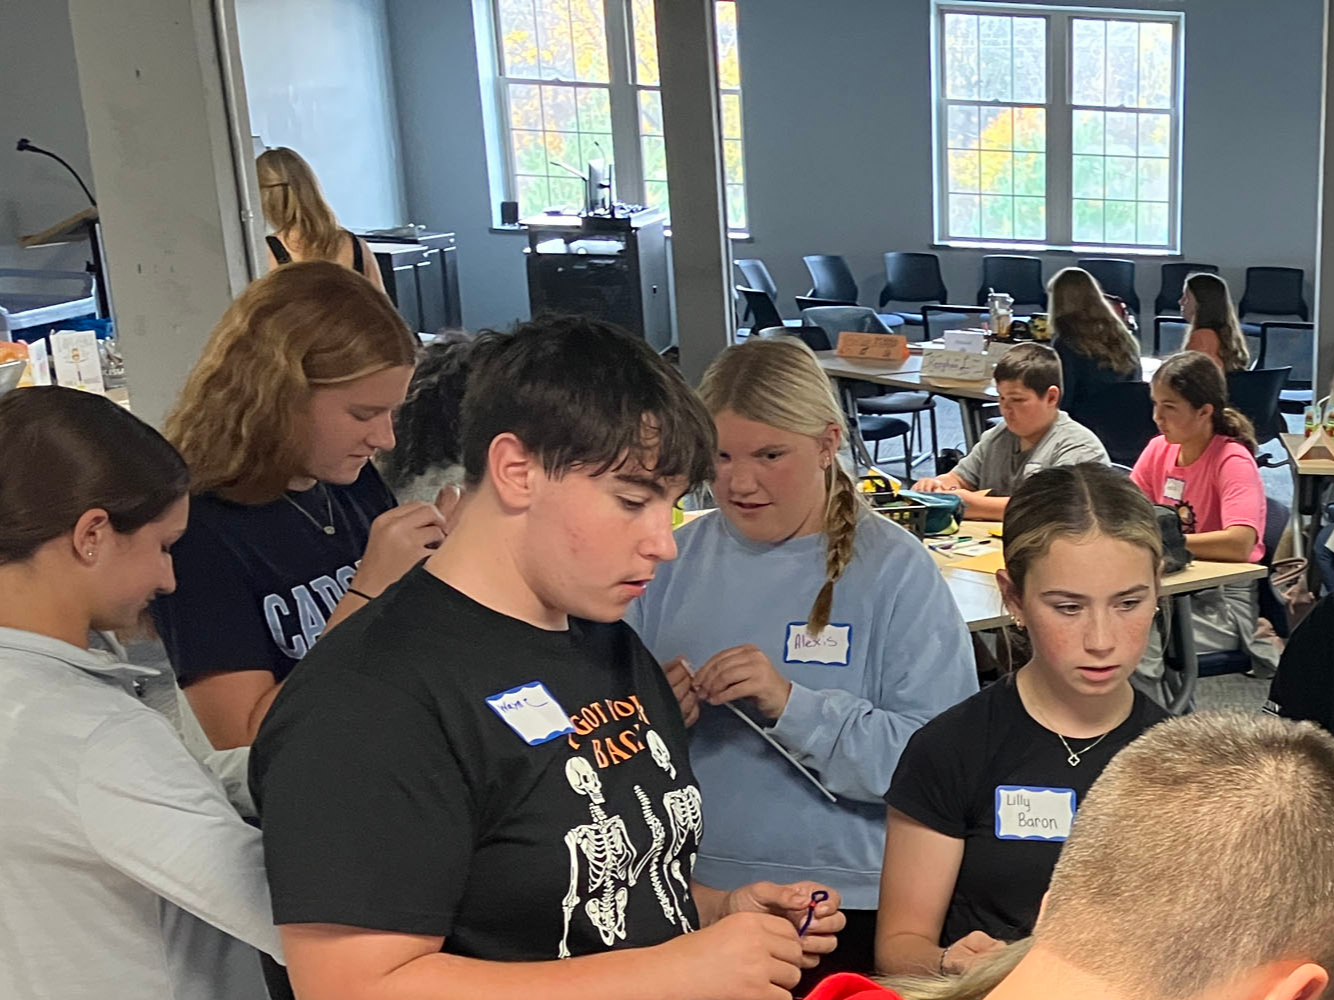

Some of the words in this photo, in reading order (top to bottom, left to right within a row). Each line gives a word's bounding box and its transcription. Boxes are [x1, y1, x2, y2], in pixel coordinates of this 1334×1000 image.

[794, 633, 838, 650] Alexis
[569, 702, 608, 735] GOT
[1006, 793, 1031, 813] Lilly
[1018, 811, 1058, 830] Baron
